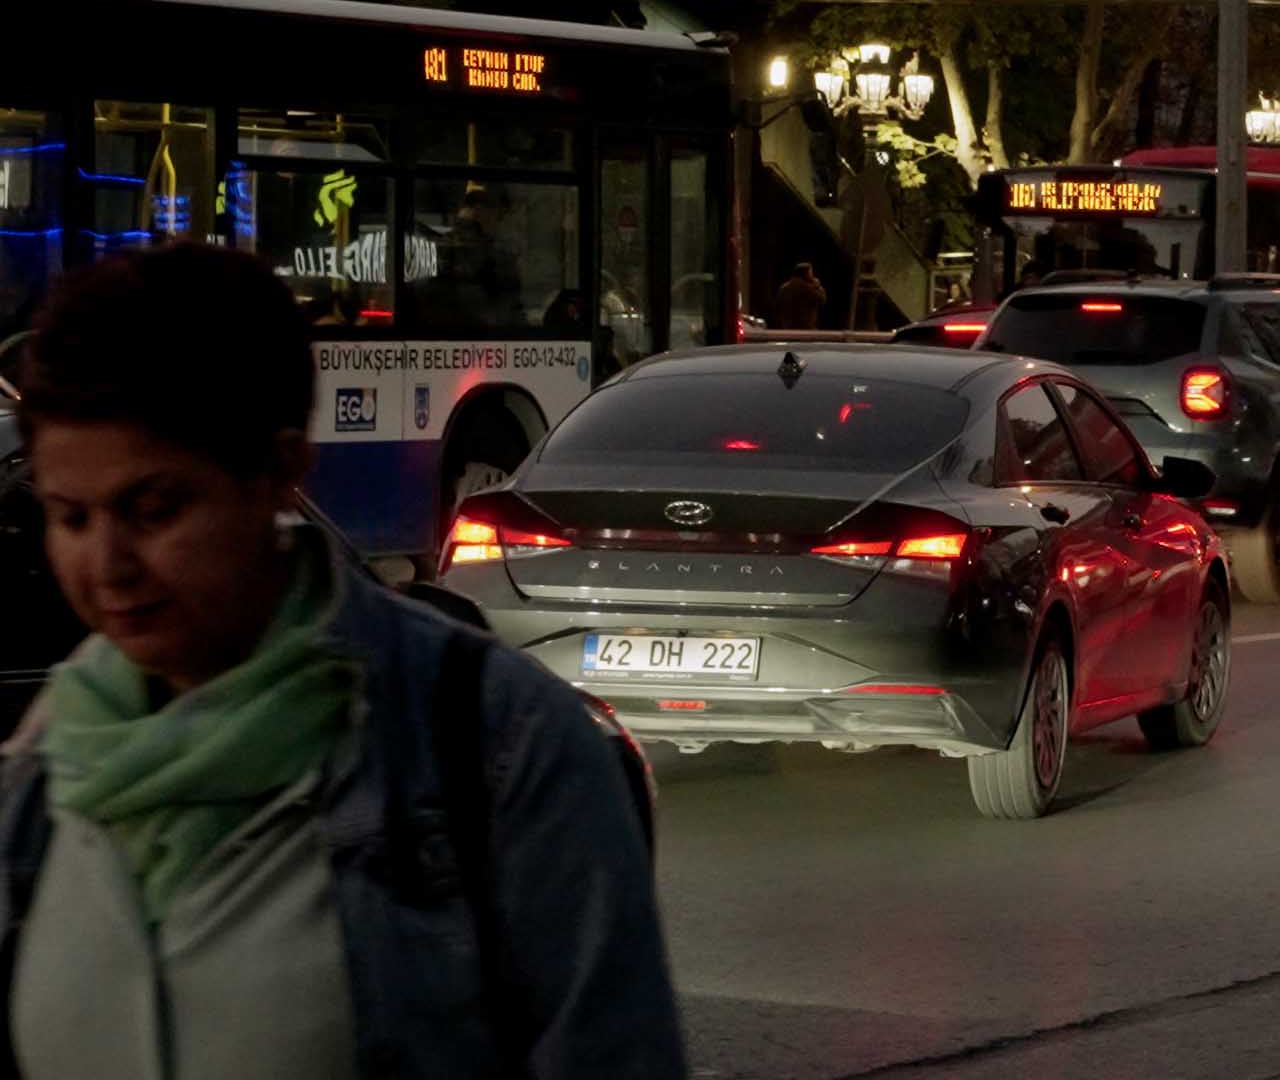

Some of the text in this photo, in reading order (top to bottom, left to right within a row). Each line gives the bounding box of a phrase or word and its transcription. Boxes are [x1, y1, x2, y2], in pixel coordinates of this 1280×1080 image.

[320, 344, 576, 375] BÜYÜKŞEHİR BELEDİYESİ EGO-12-432
[600, 638, 752, 669] 42 DH 222
